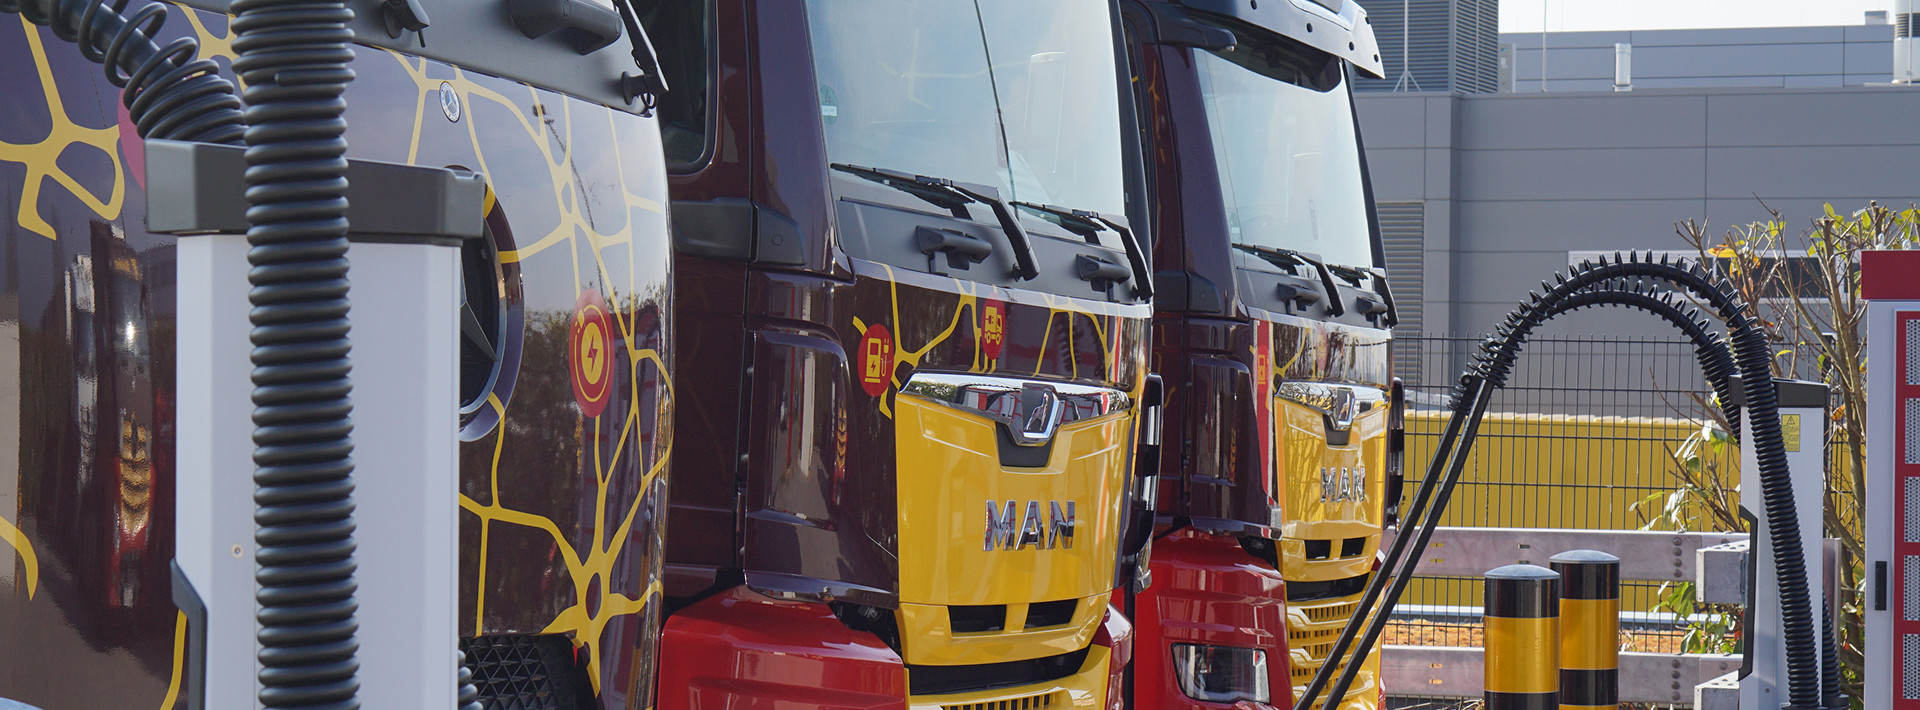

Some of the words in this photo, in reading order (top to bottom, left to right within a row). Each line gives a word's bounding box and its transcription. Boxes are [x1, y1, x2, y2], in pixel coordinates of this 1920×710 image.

[825, 87, 832, 104] 4
[1320, 467, 1365, 503] MAN
[983, 500, 1075, 551] MAN
